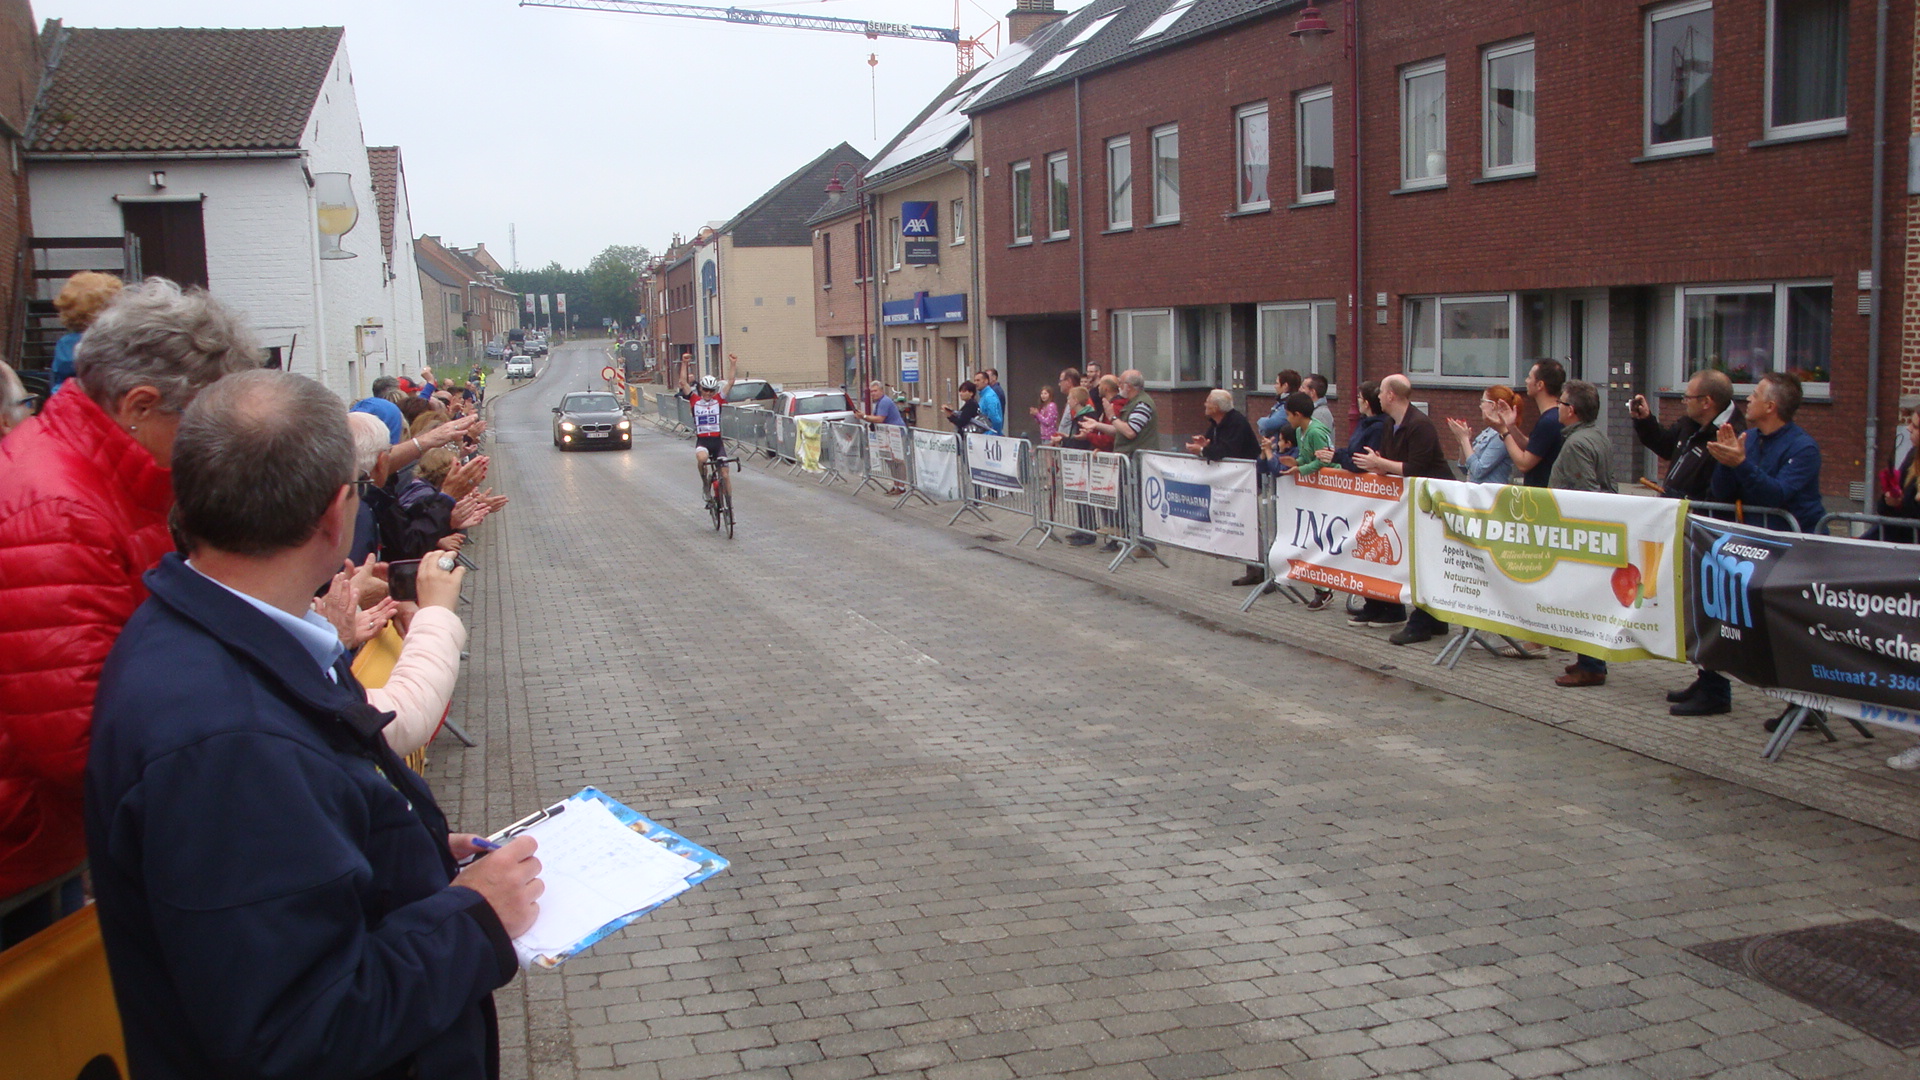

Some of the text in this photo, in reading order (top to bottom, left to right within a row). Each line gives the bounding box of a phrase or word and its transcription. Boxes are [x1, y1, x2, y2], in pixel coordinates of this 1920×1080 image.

[869, 20, 907, 33] SEMPELS
[903, 218, 930, 233] AXA
[1318, 472, 1352, 492] kantoor
[1355, 477, 1400, 497] Bierbeek
[1291, 507, 1350, 556] ING
[1444, 511, 1617, 556] VAN DER VELPEN
[1442, 544, 1464, 557] Appels
[1722, 541, 1770, 560] VASTGOED
[1444, 556, 1454, 565] uit
[1456, 558, 1473, 570] eigen
[1452, 583, 1481, 598] fruitsap
[1536, 603, 1589, 620] Rechtstreeks
[1591, 612, 1606, 623] van
[1559, 625, 1574, 634] 3360
[1574, 627, 1596, 638] Bierbeek
[1720, 625, 1741, 640] BOUW
[1817, 623, 1872, 651] Gratis
[1811, 664, 1866, 686] Eikstraat
[1868, 671, 1878, 687] 2
